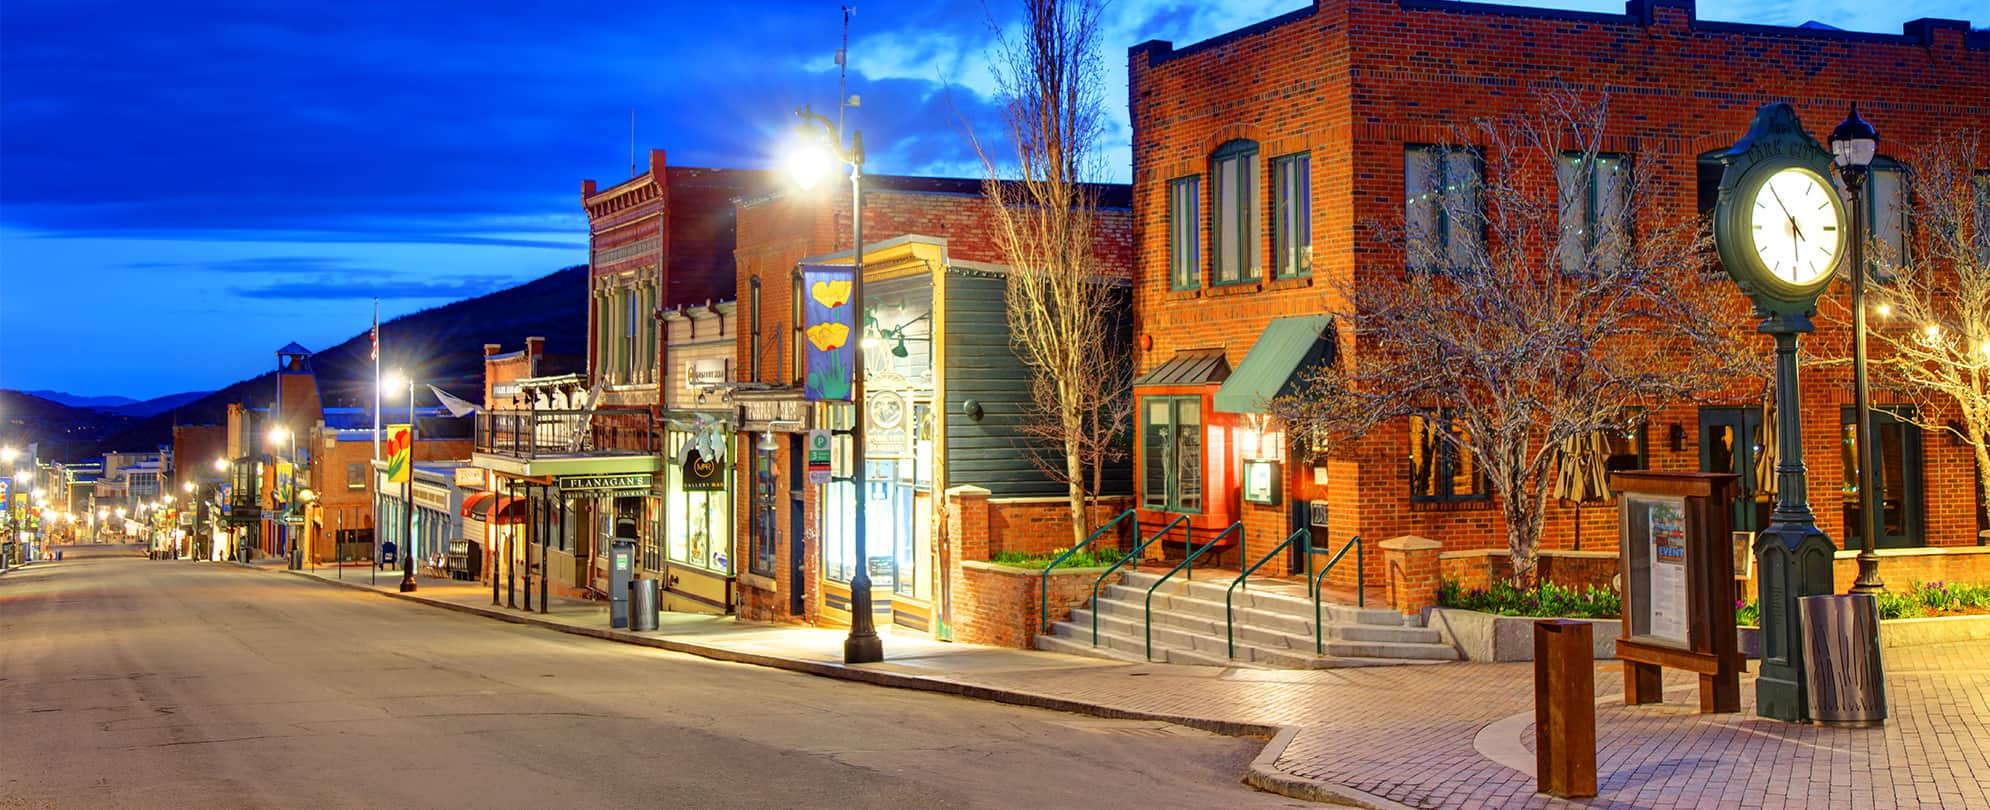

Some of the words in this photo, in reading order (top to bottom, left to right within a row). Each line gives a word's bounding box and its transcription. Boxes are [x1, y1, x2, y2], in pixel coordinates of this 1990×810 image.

[1748, 139, 1783, 162] PARK
[1791, 141, 1817, 161] CITY
[817, 437, 825, 446] P
[1658, 545, 1684, 558] EVENT
